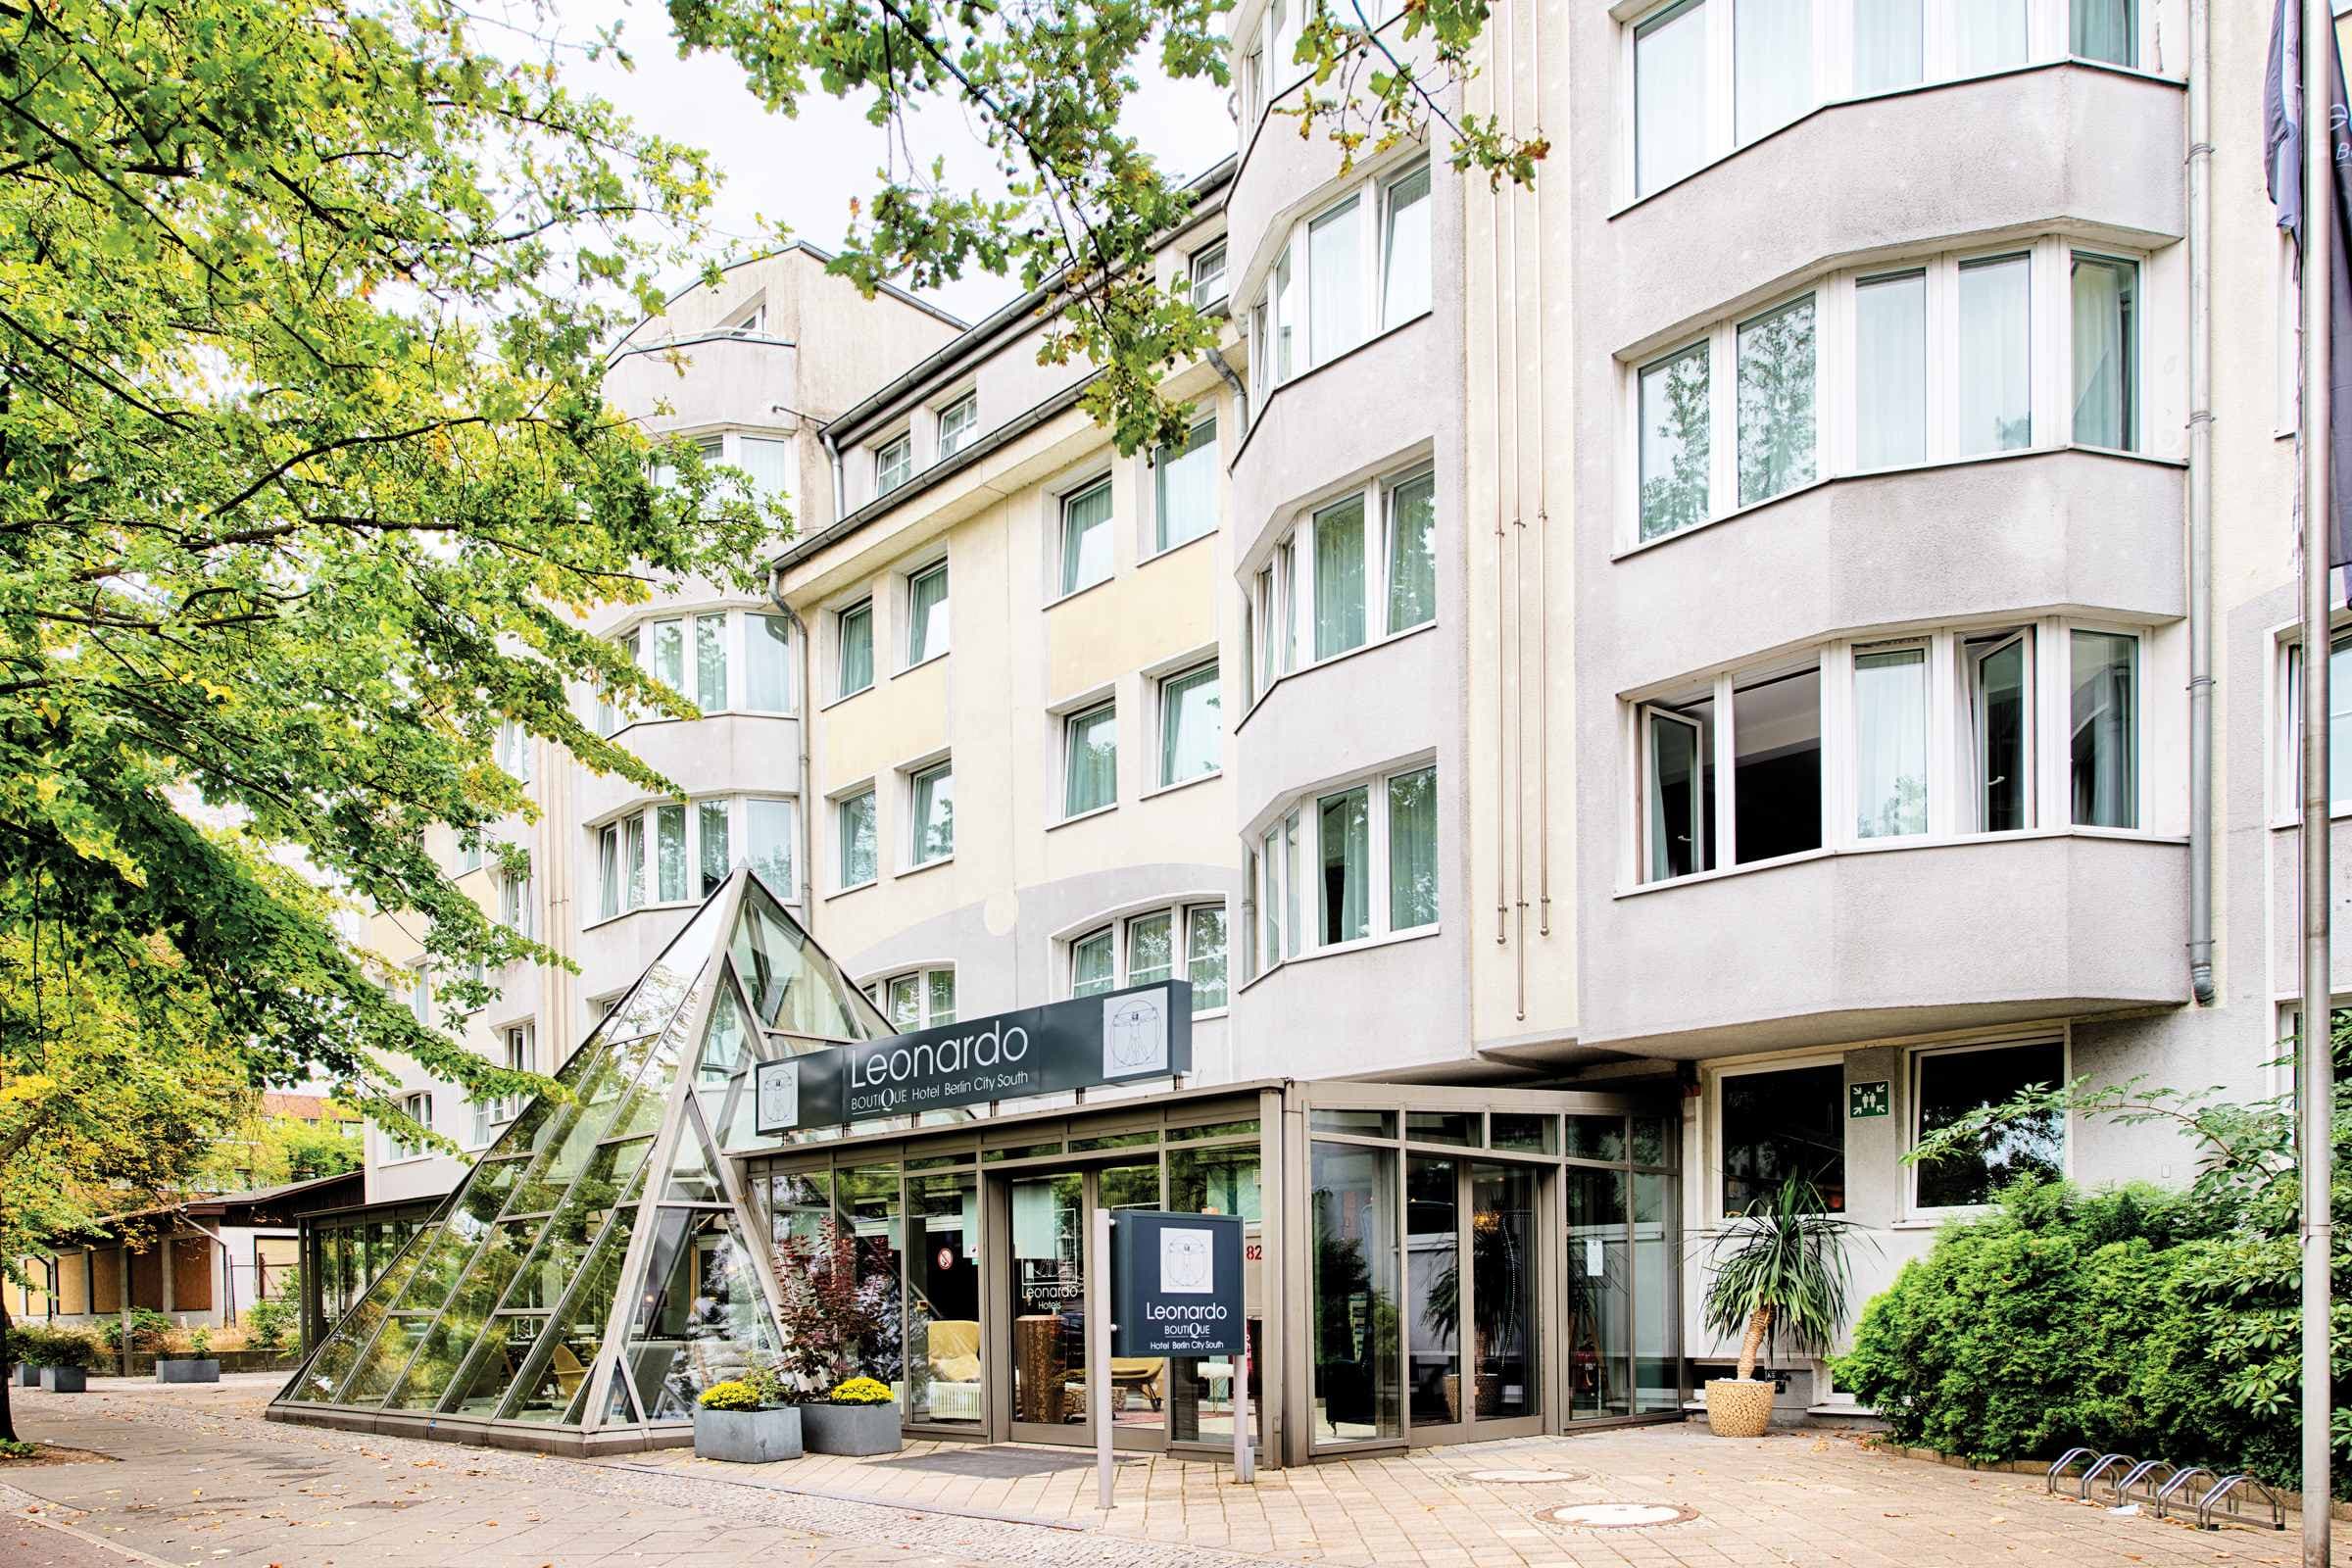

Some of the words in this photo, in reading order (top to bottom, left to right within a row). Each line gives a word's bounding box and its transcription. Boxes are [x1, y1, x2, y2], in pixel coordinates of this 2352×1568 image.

[852, 1020, 1028, 1088] Leonardo
[851, 1088, 906, 1111] BOUTIQUE
[912, 1084, 940, 1101] Hotel
[945, 1081, 971, 1096] Berlin
[974, 1076, 996, 1092] City
[997, 1070, 1028, 1088] South
[1246, 1245, 1262, 1260] 82
[1022, 1284, 1078, 1298] Leonardo
[1039, 1300, 1061, 1310] Hotels
[1147, 1301, 1227, 1320] Leonardo
[1164, 1322, 1210, 1339] BOUTIQUE
[1172, 1341, 1190, 1349] Berlin
[1191, 1341, 1204, 1350] City
[1204, 1340, 1224, 1349] South
